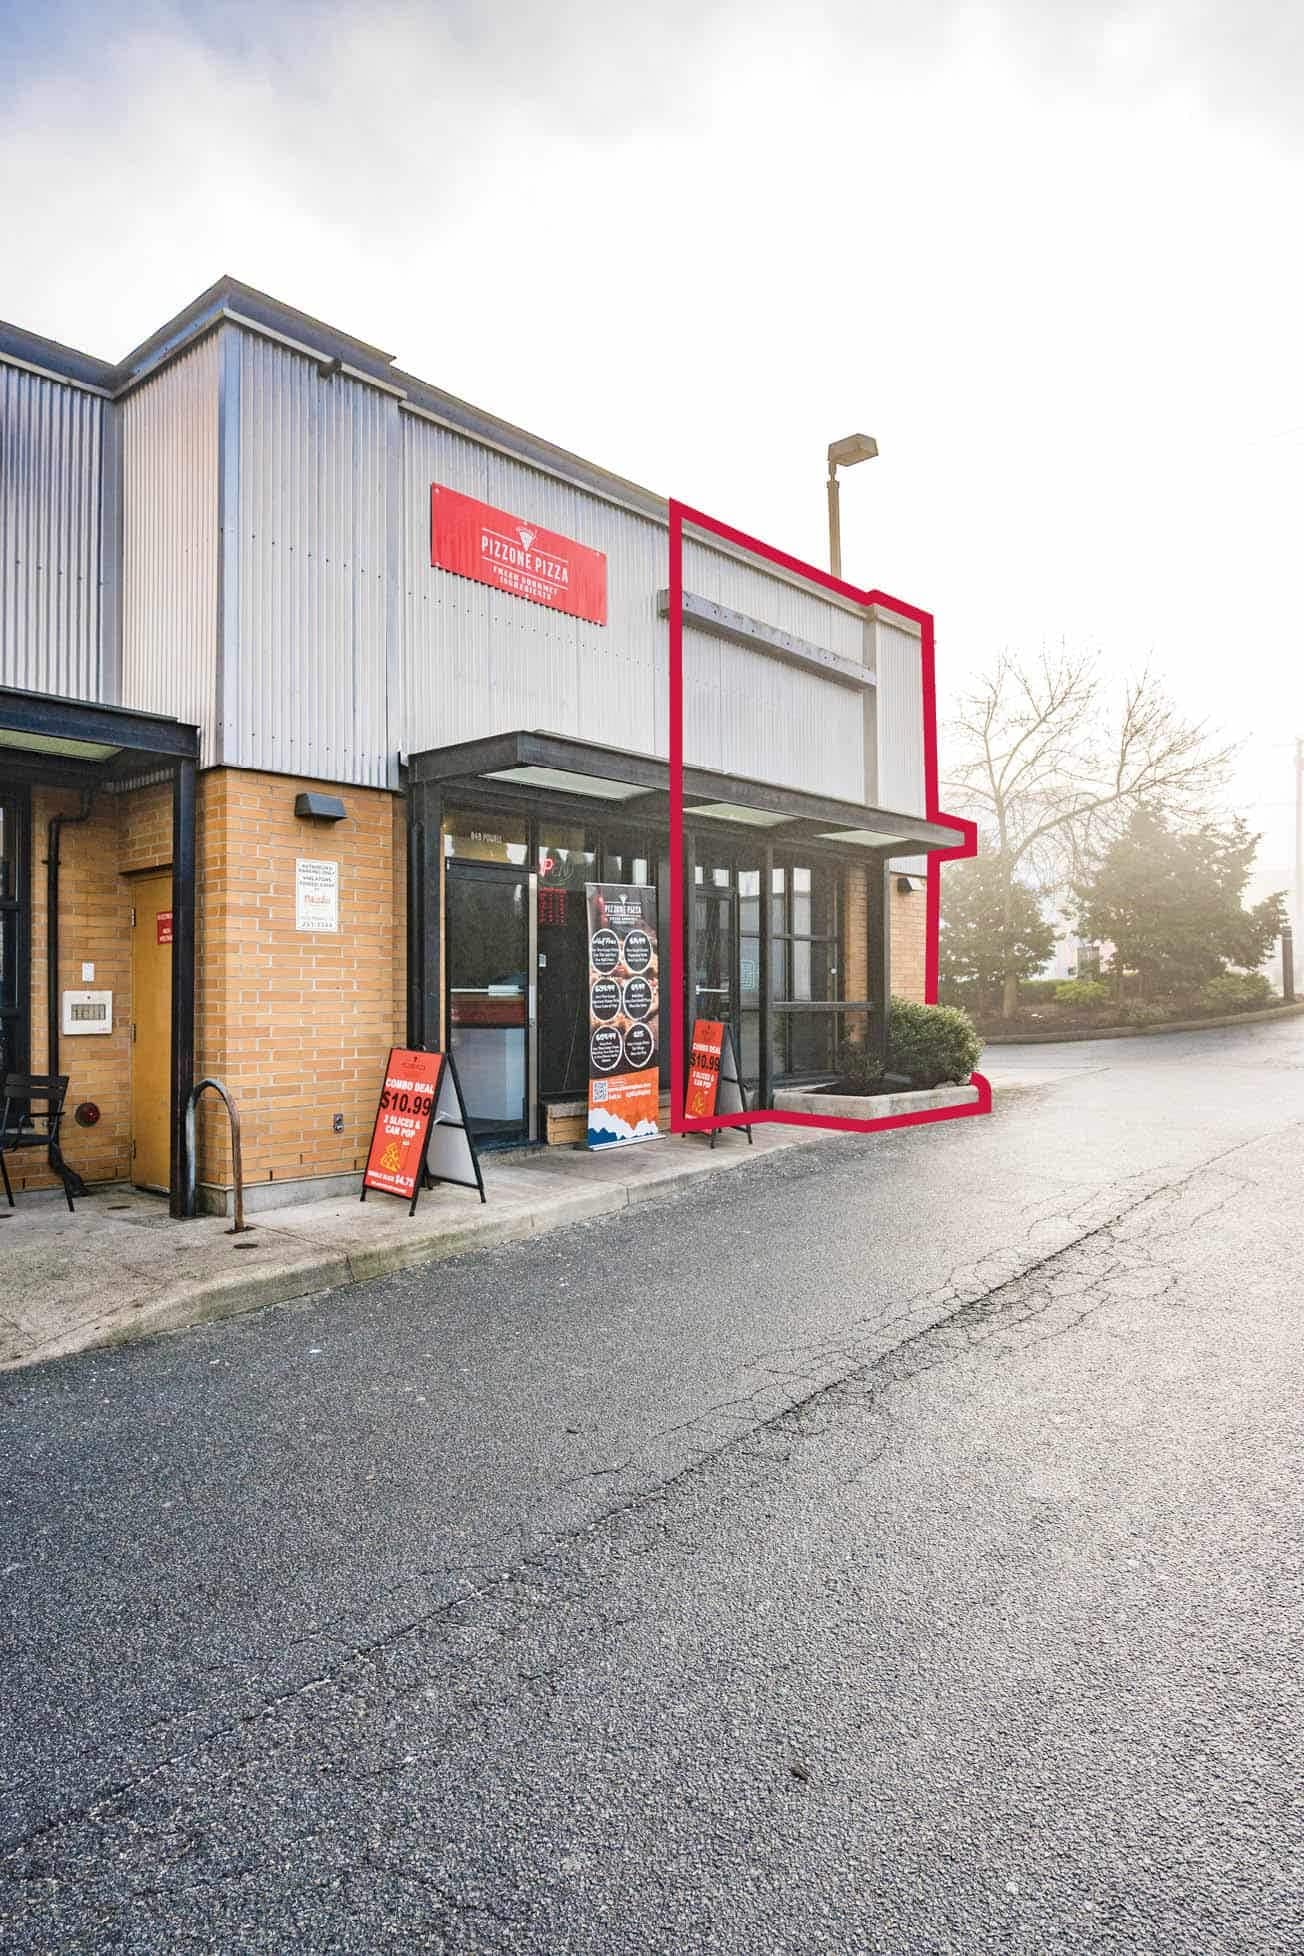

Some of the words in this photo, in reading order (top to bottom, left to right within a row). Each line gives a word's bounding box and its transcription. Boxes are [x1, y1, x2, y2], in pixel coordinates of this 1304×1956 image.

[481, 535, 532, 570] PIZZONE
[535, 556, 569, 584] PIZZA
[690, 1053, 720, 1071] $10.99
[385, 1077, 413, 1091] COMBO
[414, 1081, 435, 1095] DEAL
[380, 1091, 432, 1116] $10.99
[389, 1115, 415, 1129] SLICES
[385, 1125, 400, 1136] CAN
[400, 1128, 416, 1139] POP
